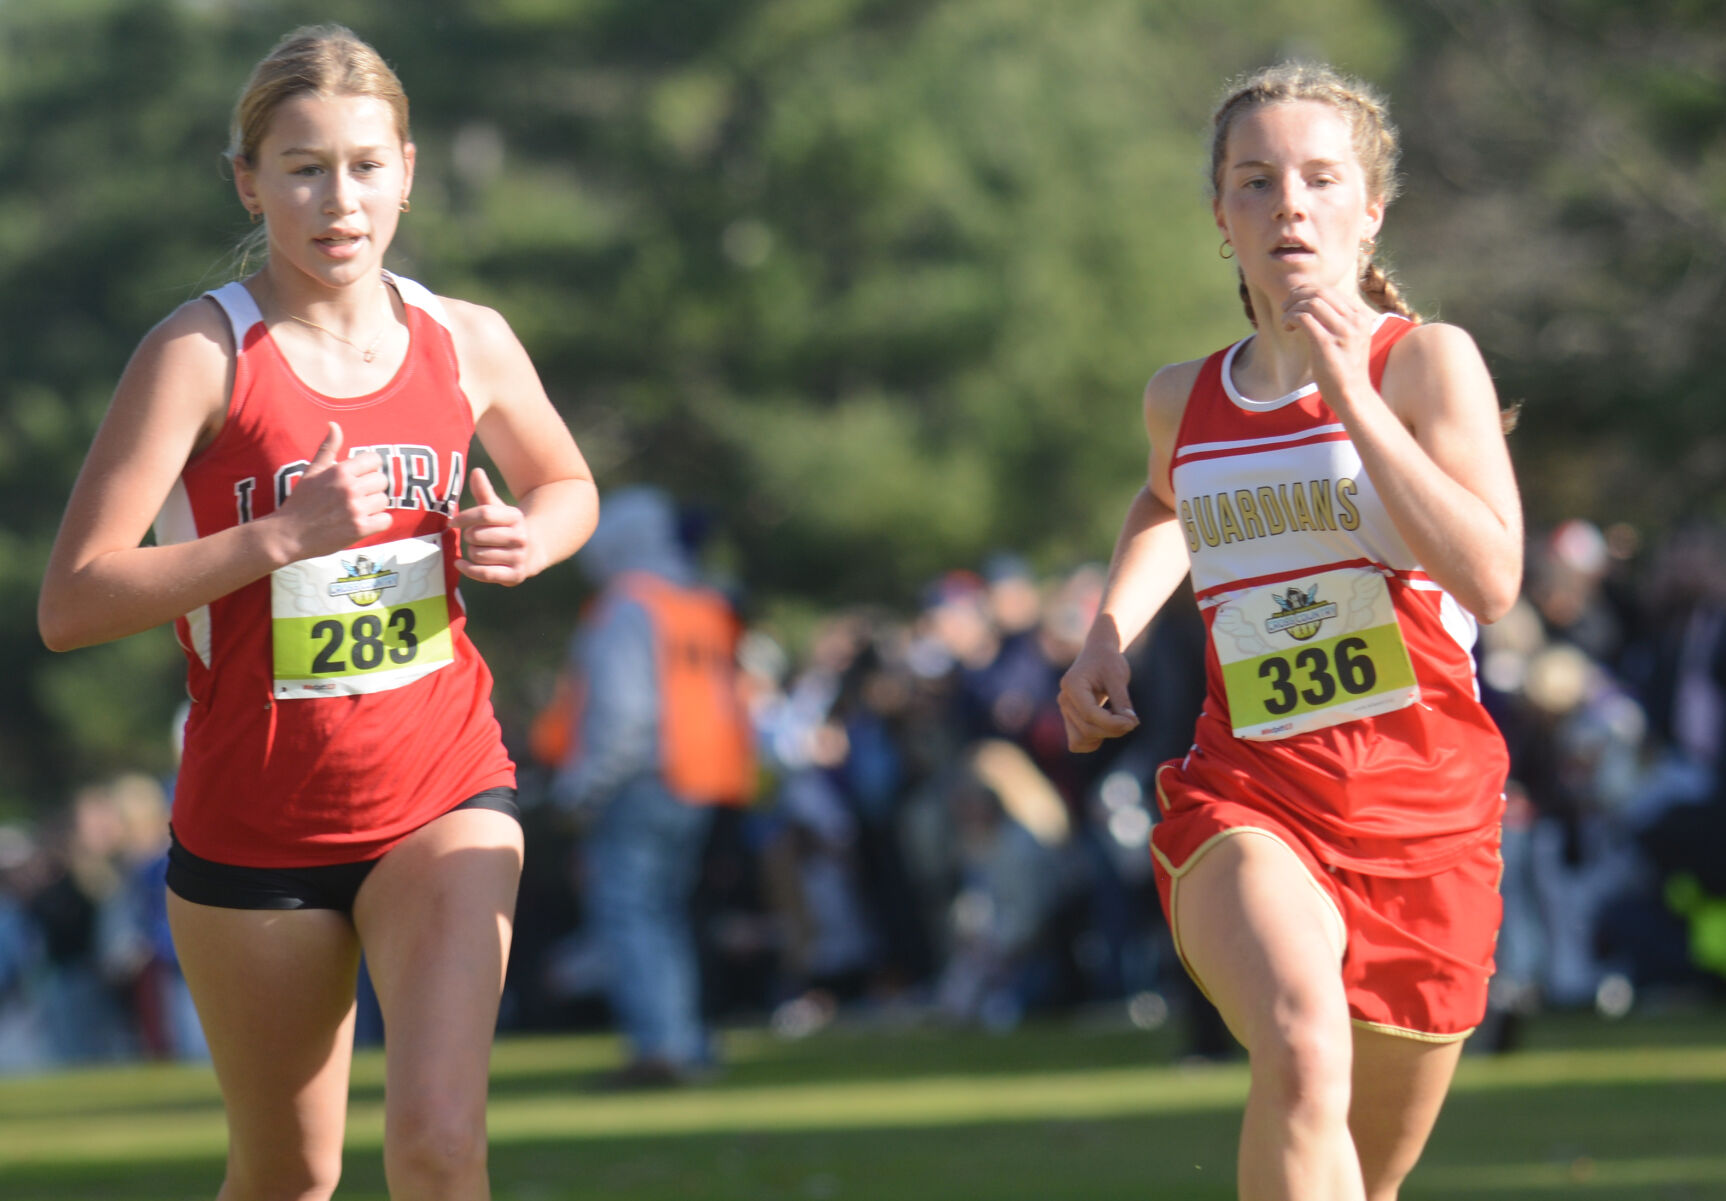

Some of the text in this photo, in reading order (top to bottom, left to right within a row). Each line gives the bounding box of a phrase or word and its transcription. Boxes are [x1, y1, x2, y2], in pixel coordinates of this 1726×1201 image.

[1181, 477, 1361, 553] GUARDIANS
[311, 608, 418, 674] 283
[1258, 637, 1376, 715] 336
